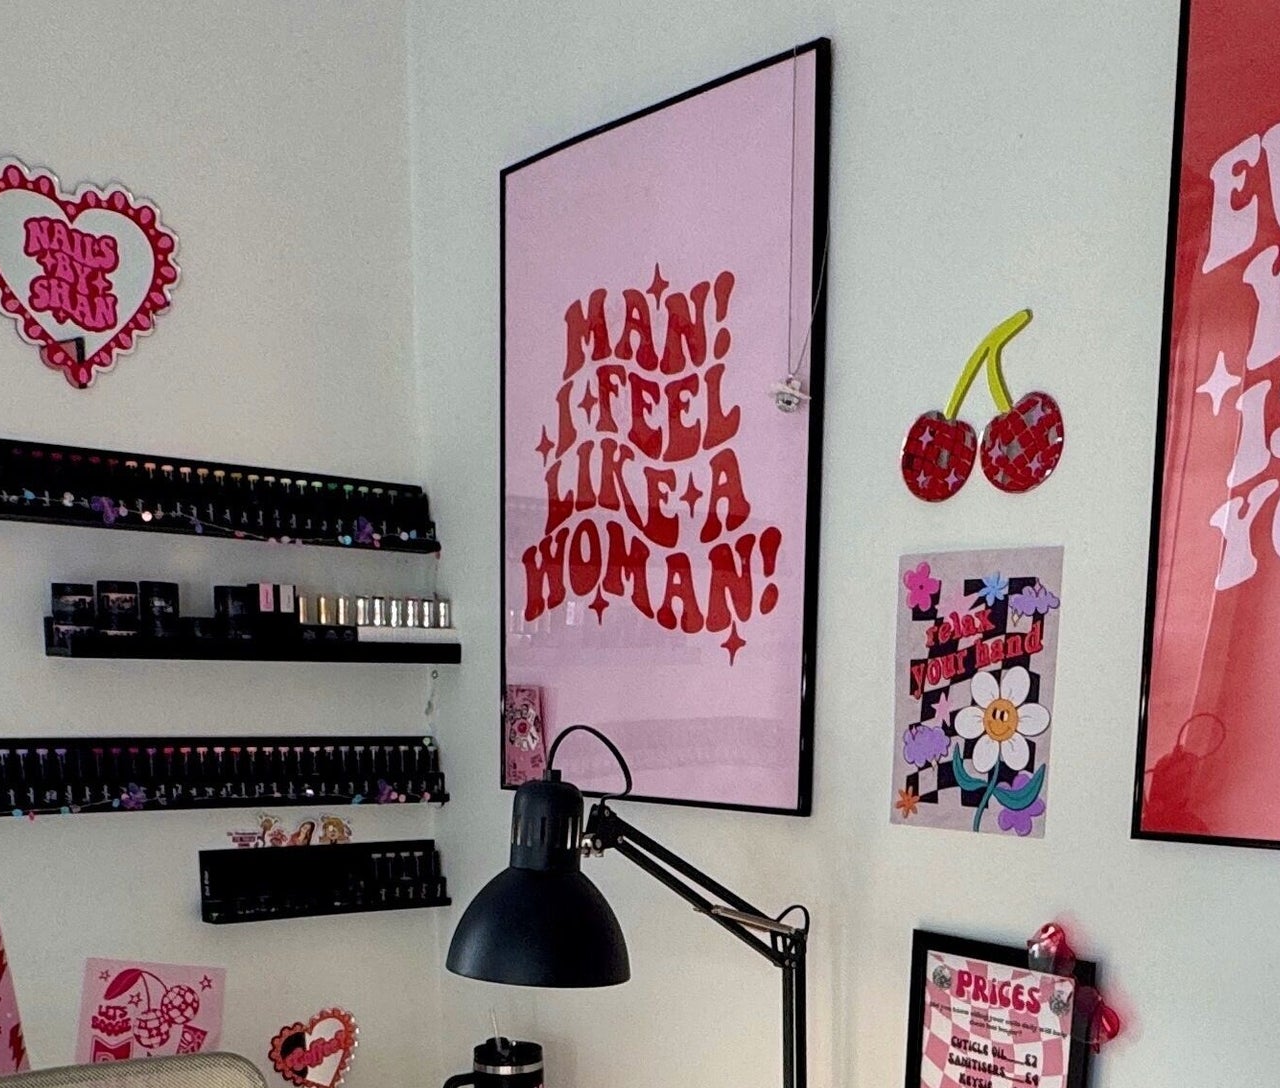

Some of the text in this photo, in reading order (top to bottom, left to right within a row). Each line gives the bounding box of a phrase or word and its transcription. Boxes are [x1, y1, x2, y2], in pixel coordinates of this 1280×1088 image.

[25, 217, 118, 270] NAILS
[56, 254, 90, 294] BY
[31, 279, 117, 329] SHAN
[563, 271, 735, 380] MAN!
[555, 363, 741, 461] I FEEL
[544, 438, 751, 547] LIKE A
[522, 519, 782, 633] WOMAN!
[911, 621, 1043, 699] your hand
[925, 607, 995, 648] relax
